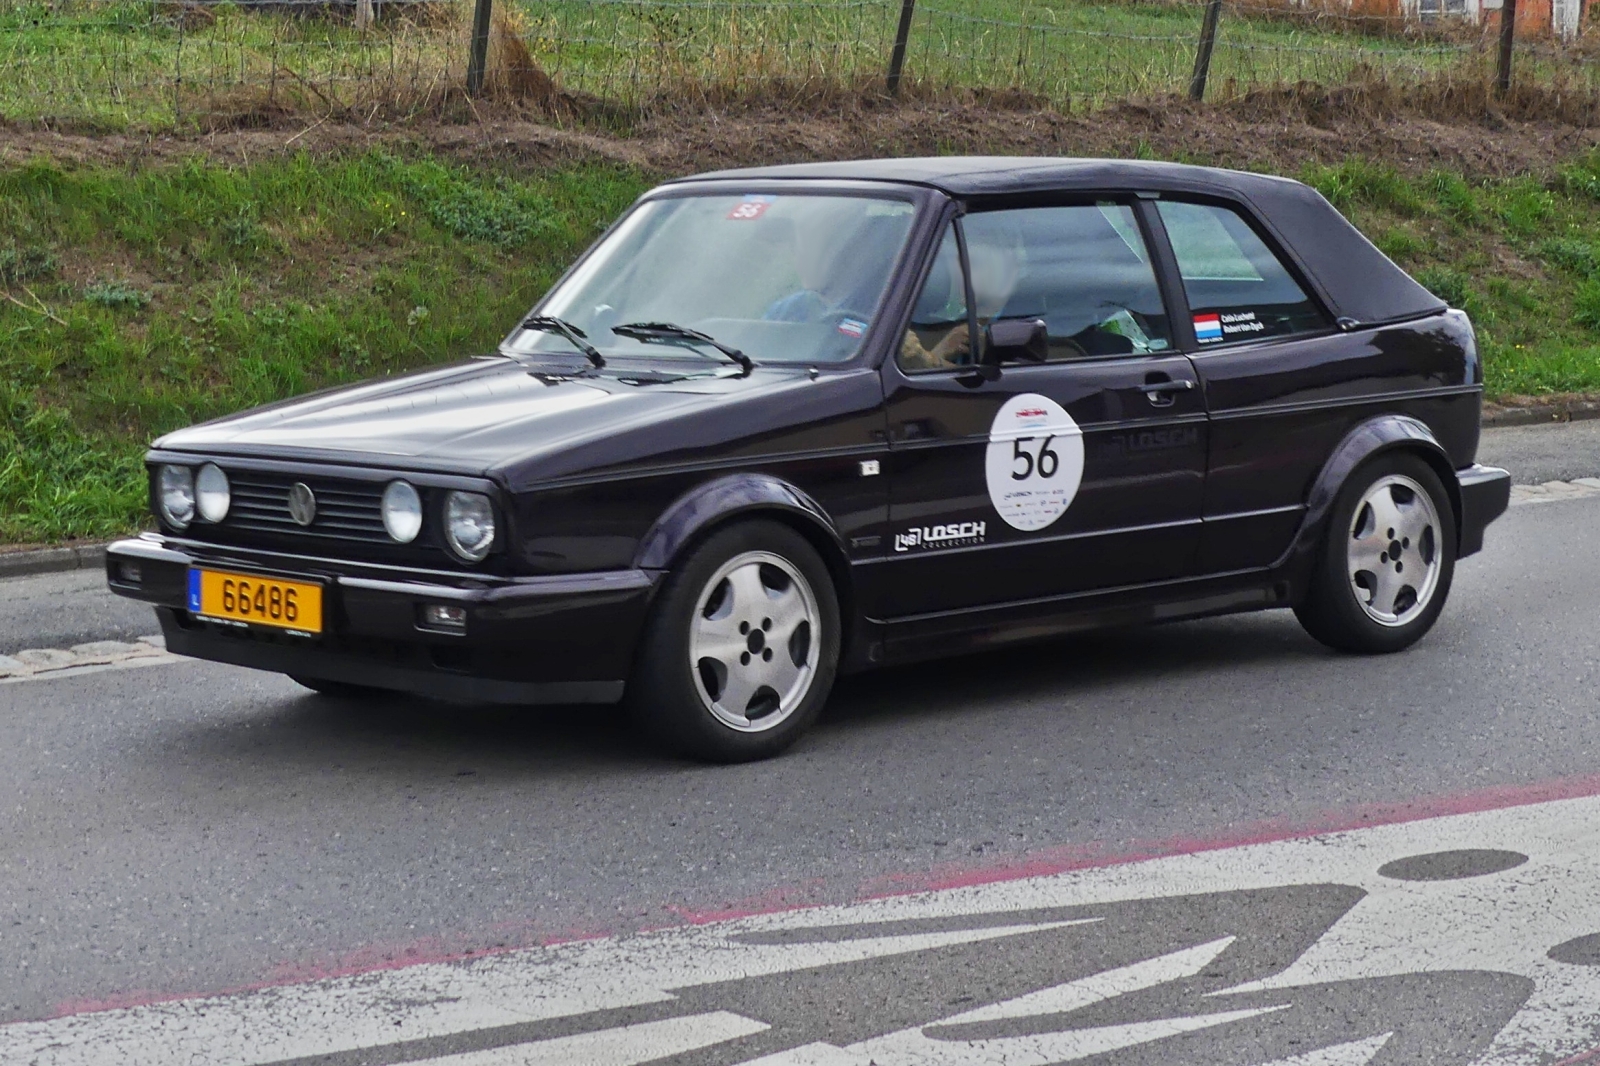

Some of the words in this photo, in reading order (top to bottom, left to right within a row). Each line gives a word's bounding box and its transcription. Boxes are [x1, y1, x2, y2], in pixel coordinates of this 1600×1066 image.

[732, 203, 762, 218] 56
[1011, 433, 1059, 481] 56
[923, 521, 986, 542] LOSCH
[223, 578, 298, 622] 66486
